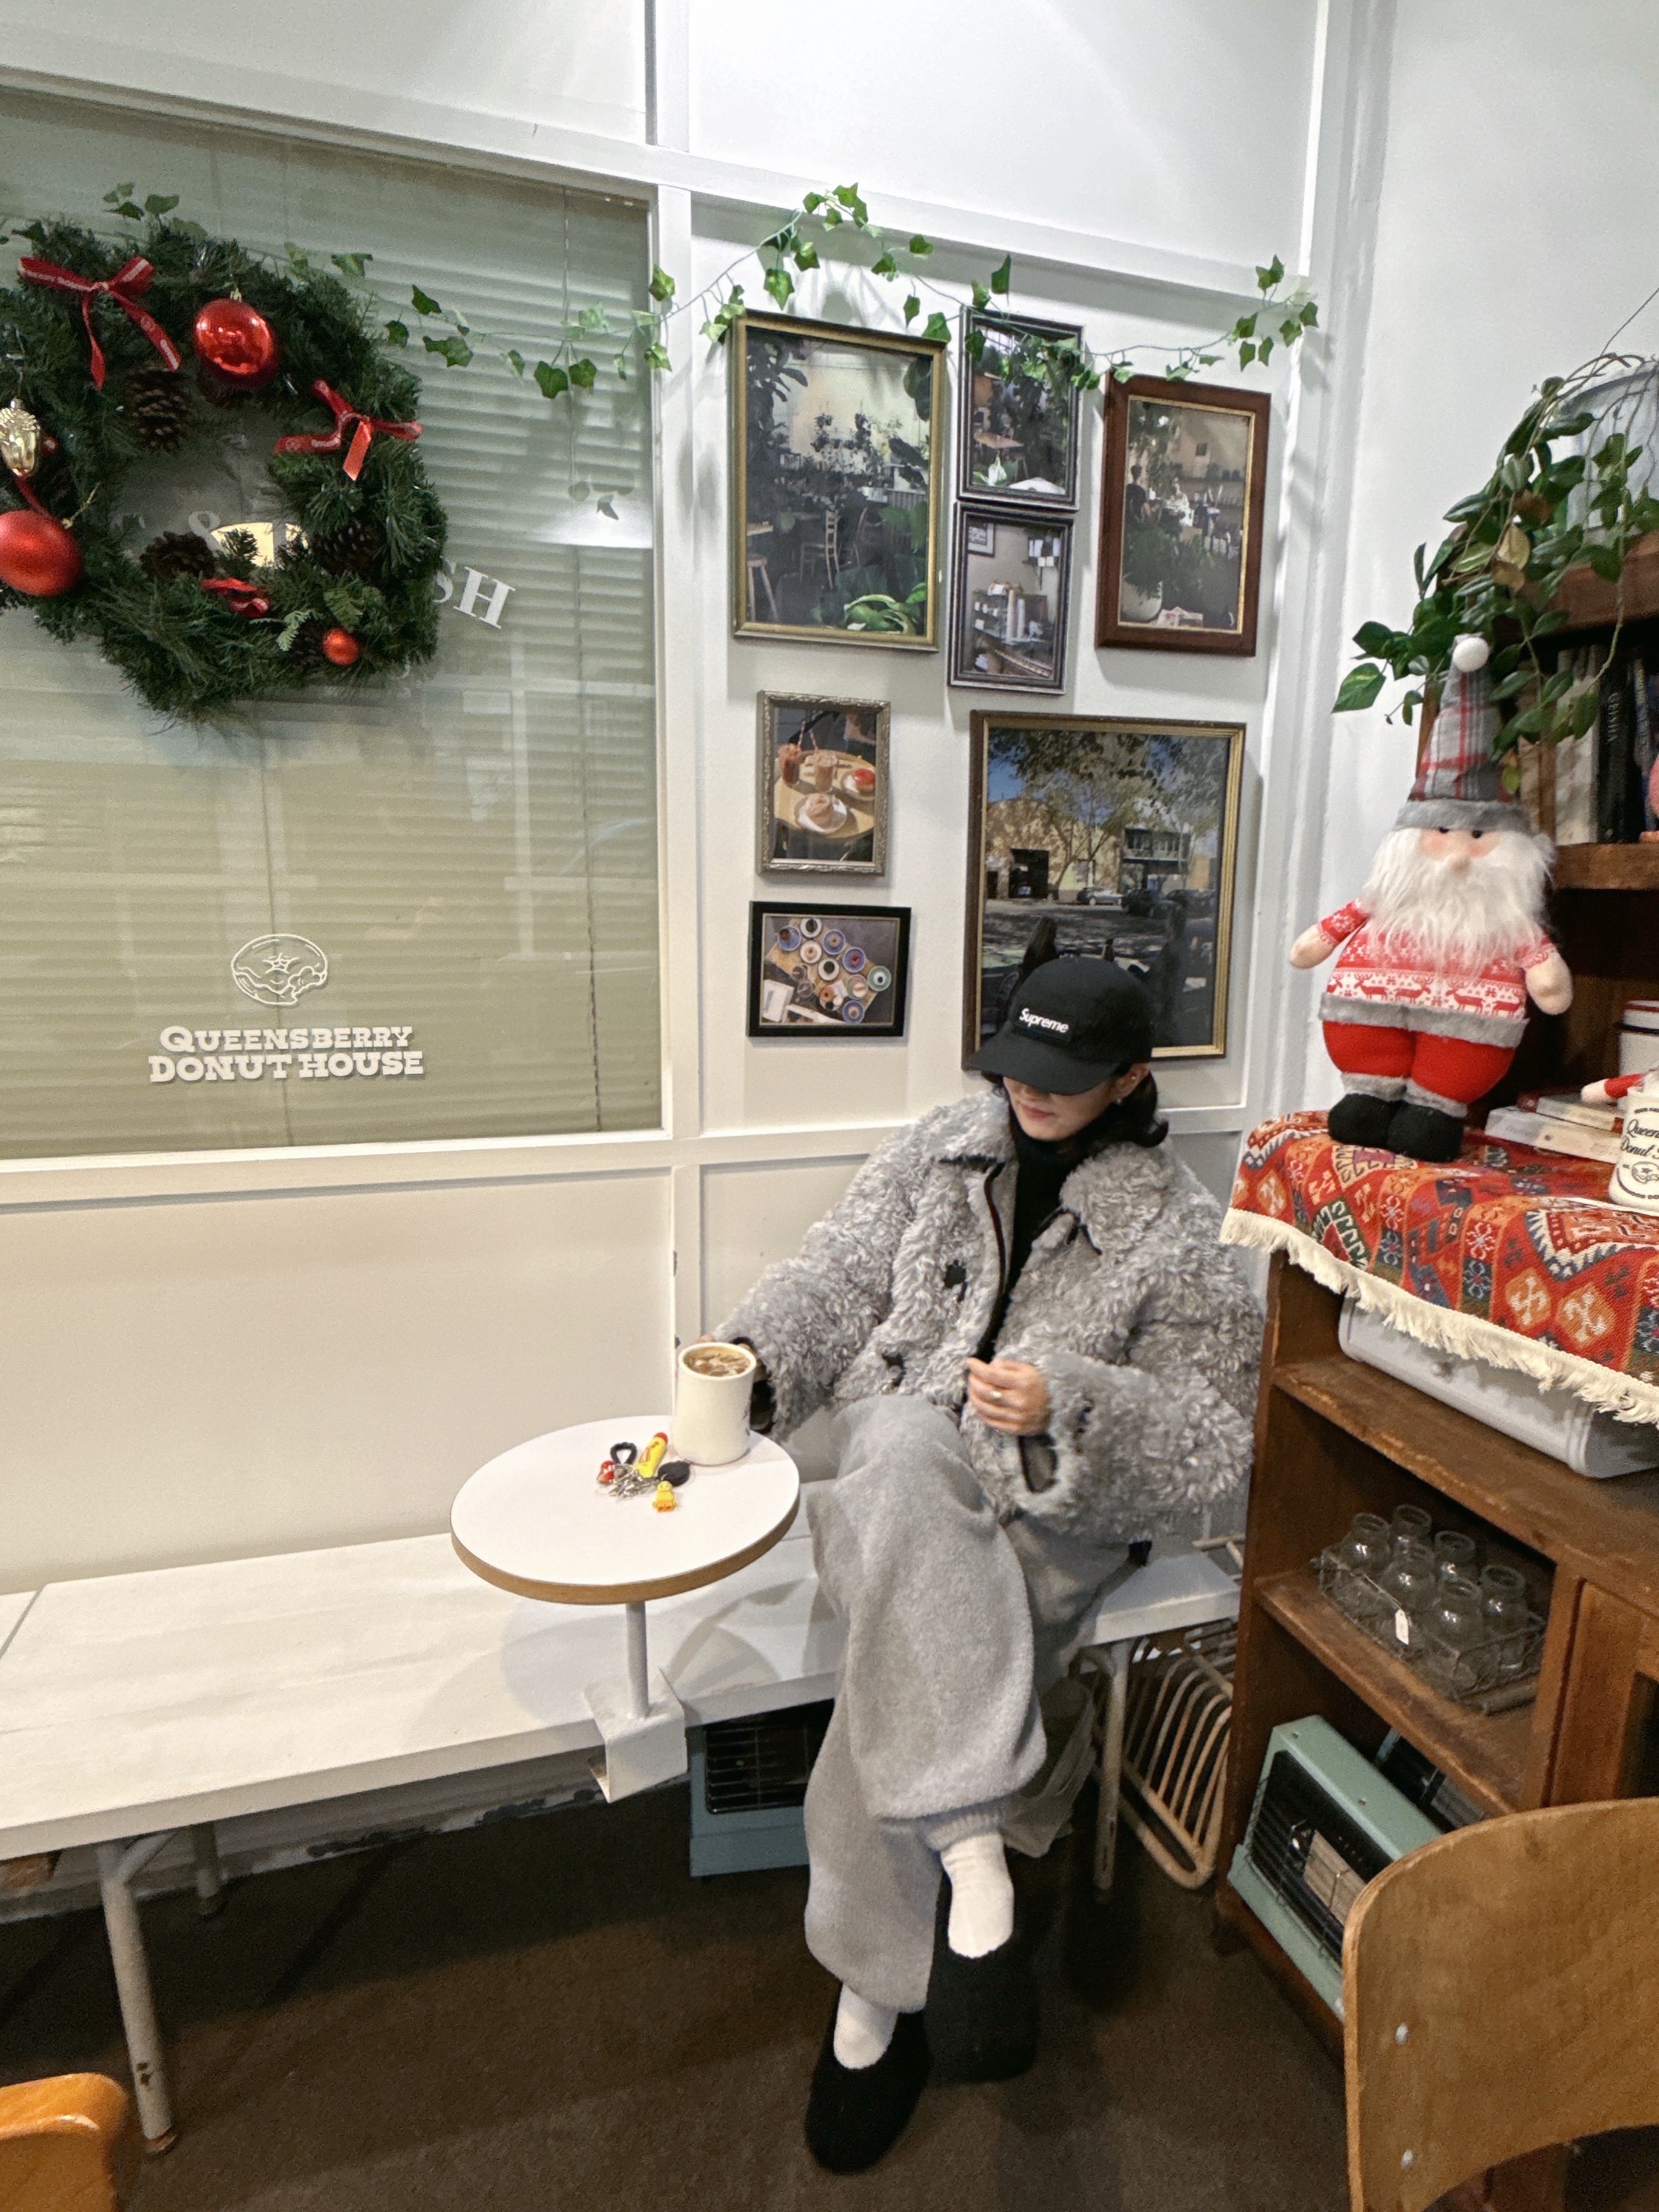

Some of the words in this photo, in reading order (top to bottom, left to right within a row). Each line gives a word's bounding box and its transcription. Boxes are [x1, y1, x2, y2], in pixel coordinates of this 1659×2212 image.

[1019, 1008, 1069, 1033] Supreme
[160, 1025, 413, 1053] QUEENSBERRY
[148, 1054, 292, 1082] DONUT
[298, 1051, 424, 1079] HOUSE
